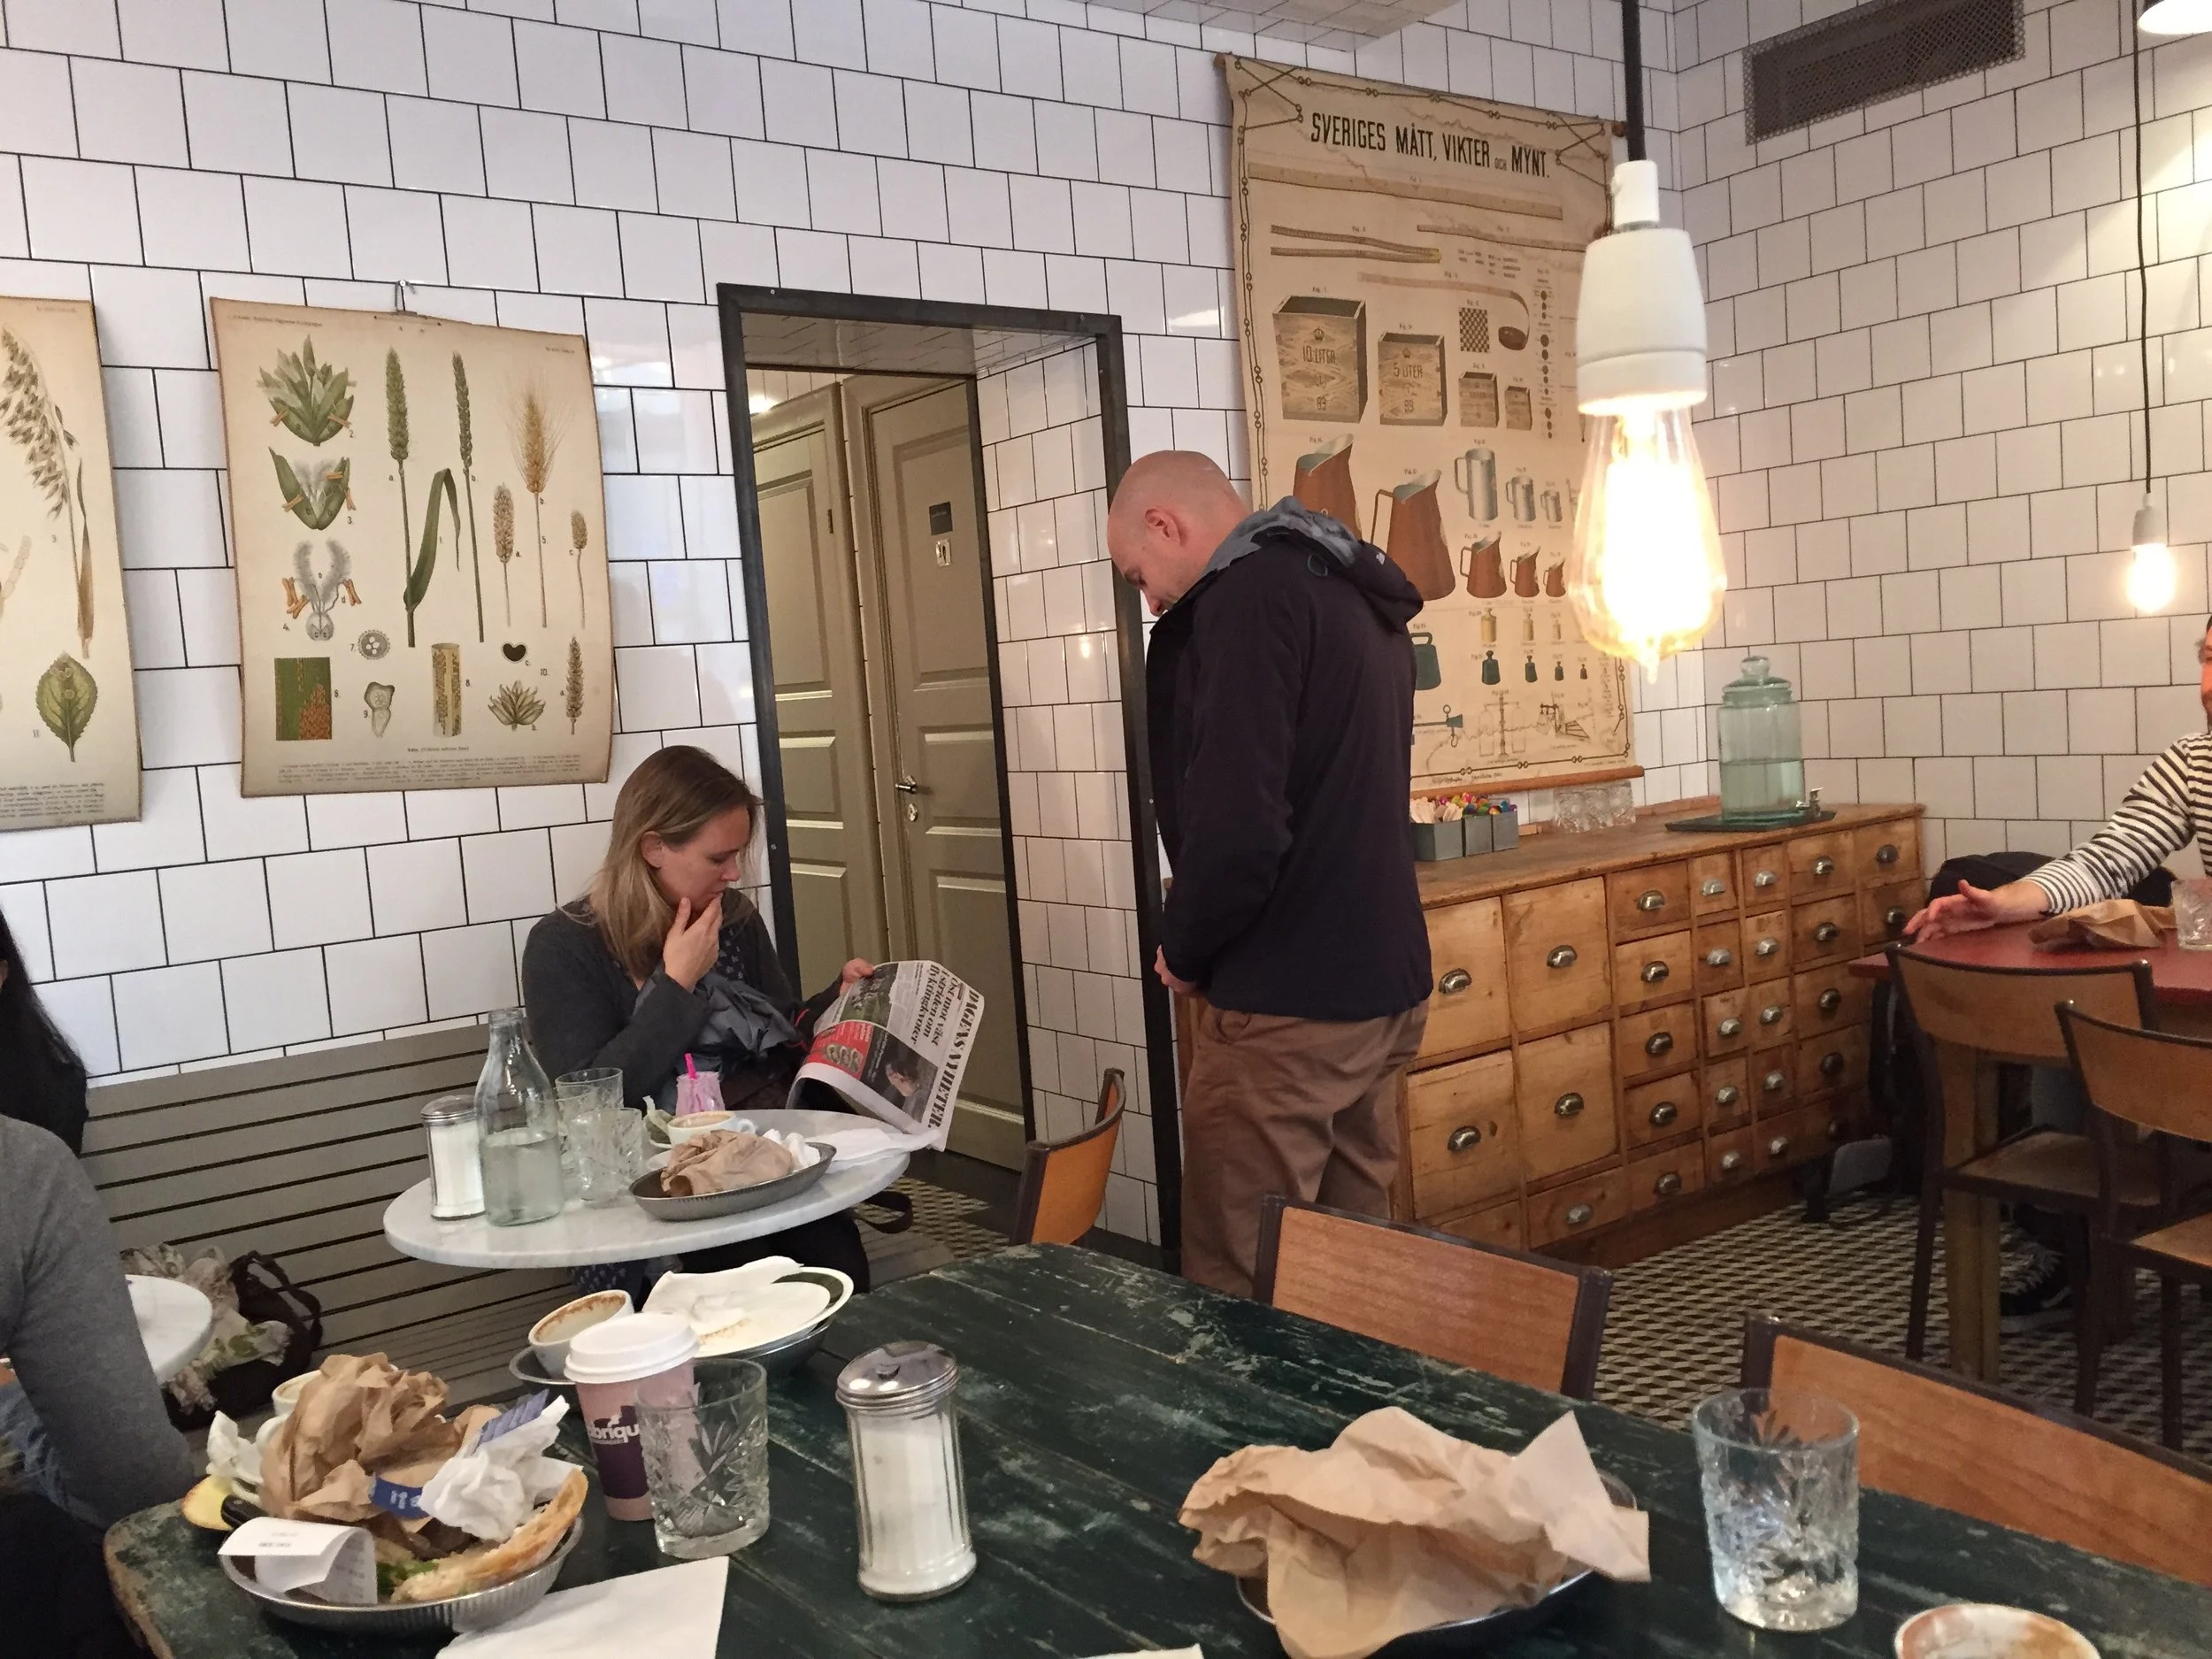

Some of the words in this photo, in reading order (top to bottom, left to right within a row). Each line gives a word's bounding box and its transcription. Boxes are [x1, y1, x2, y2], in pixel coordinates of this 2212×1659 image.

[1310, 113, 1386, 151] SVERIGES
[1395, 123, 1437, 162] MÅTT,
[1442, 133, 1490, 168] VIKTER
[1511, 145, 1549, 179] MYNT.
[1394, 363, 1401, 377] 5
[910, 964, 940, 1044] flyktingkvoter
[929, 976, 946, 1017] striden
[939, 997, 952, 1021] mot
[923, 1018, 933, 1038] om
[932, 1023, 943, 1046] väst
[954, 989, 979, 1050] DAGENS
[928, 1052, 962, 1128] NYHETER.
